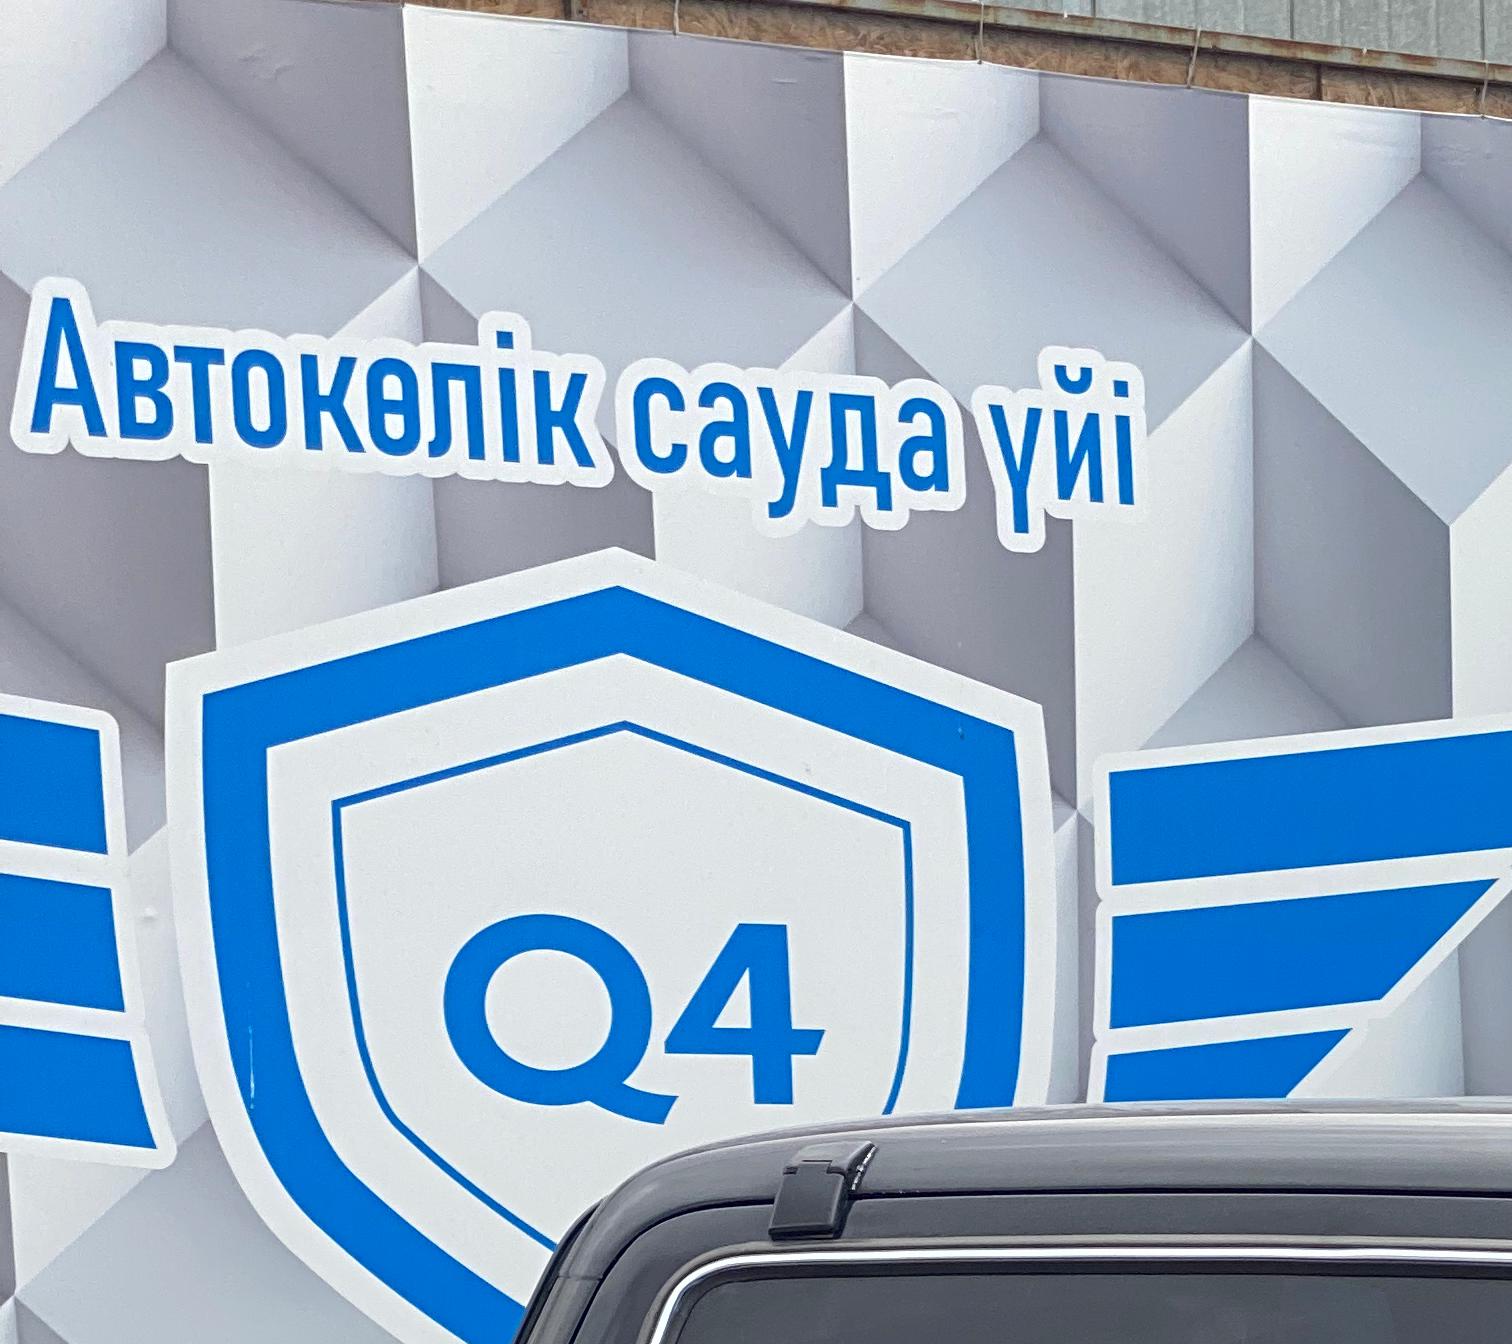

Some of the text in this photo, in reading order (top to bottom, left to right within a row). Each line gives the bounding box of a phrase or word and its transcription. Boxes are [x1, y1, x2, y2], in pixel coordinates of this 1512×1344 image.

[32, 297, 1134, 533] Автокөлік сауда үйі
[444, 914, 824, 1124] Q4
